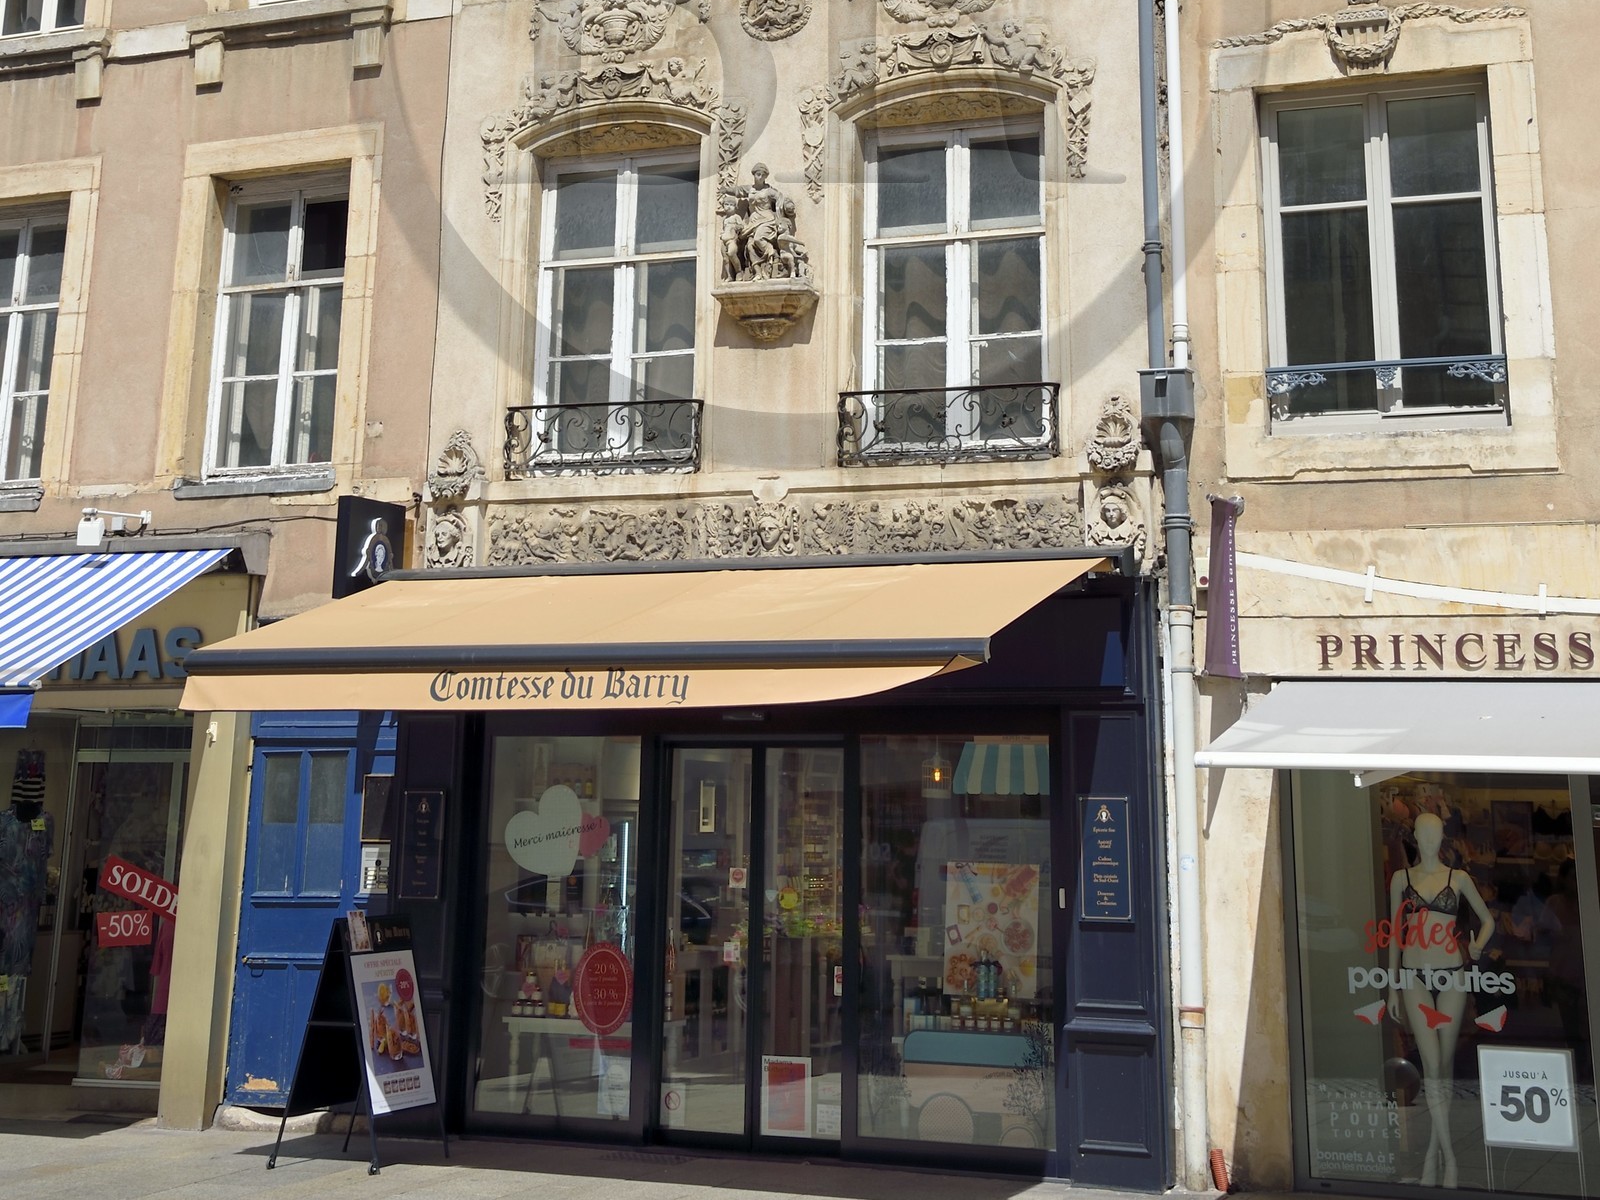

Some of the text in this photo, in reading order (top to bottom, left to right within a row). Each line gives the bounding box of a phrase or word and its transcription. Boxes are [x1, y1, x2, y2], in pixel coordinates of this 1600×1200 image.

[1229, 588, 1238, 665] PRINCESSE
[430, 666, 690, 705] Comtesse du Barry
[513, 833, 544, 849] Merci
[101, 913, 149, 937] -50%
[1364, 898, 1461, 954] soldes
[594, 963, 607, 974] 20
[1348, 964, 1516, 994] pour toutes
[593, 988, 607, 1000] 30
[1502, 1070, 1548, 1080] JUSQU'À
[1327, 1091, 1397, 1099] PRINCESSE
[1330, 1101, 1399, 1110] TAMTAM
[1490, 1085, 1568, 1124] -50%
[1330, 1111, 1400, 1127] POUR
[1332, 1128, 1402, 1138] TOUTES
[1366, 1152, 1375, 1163] A
[1377, 1151, 1386, 1163] à
[1341, 1161, 1355, 1170] les
